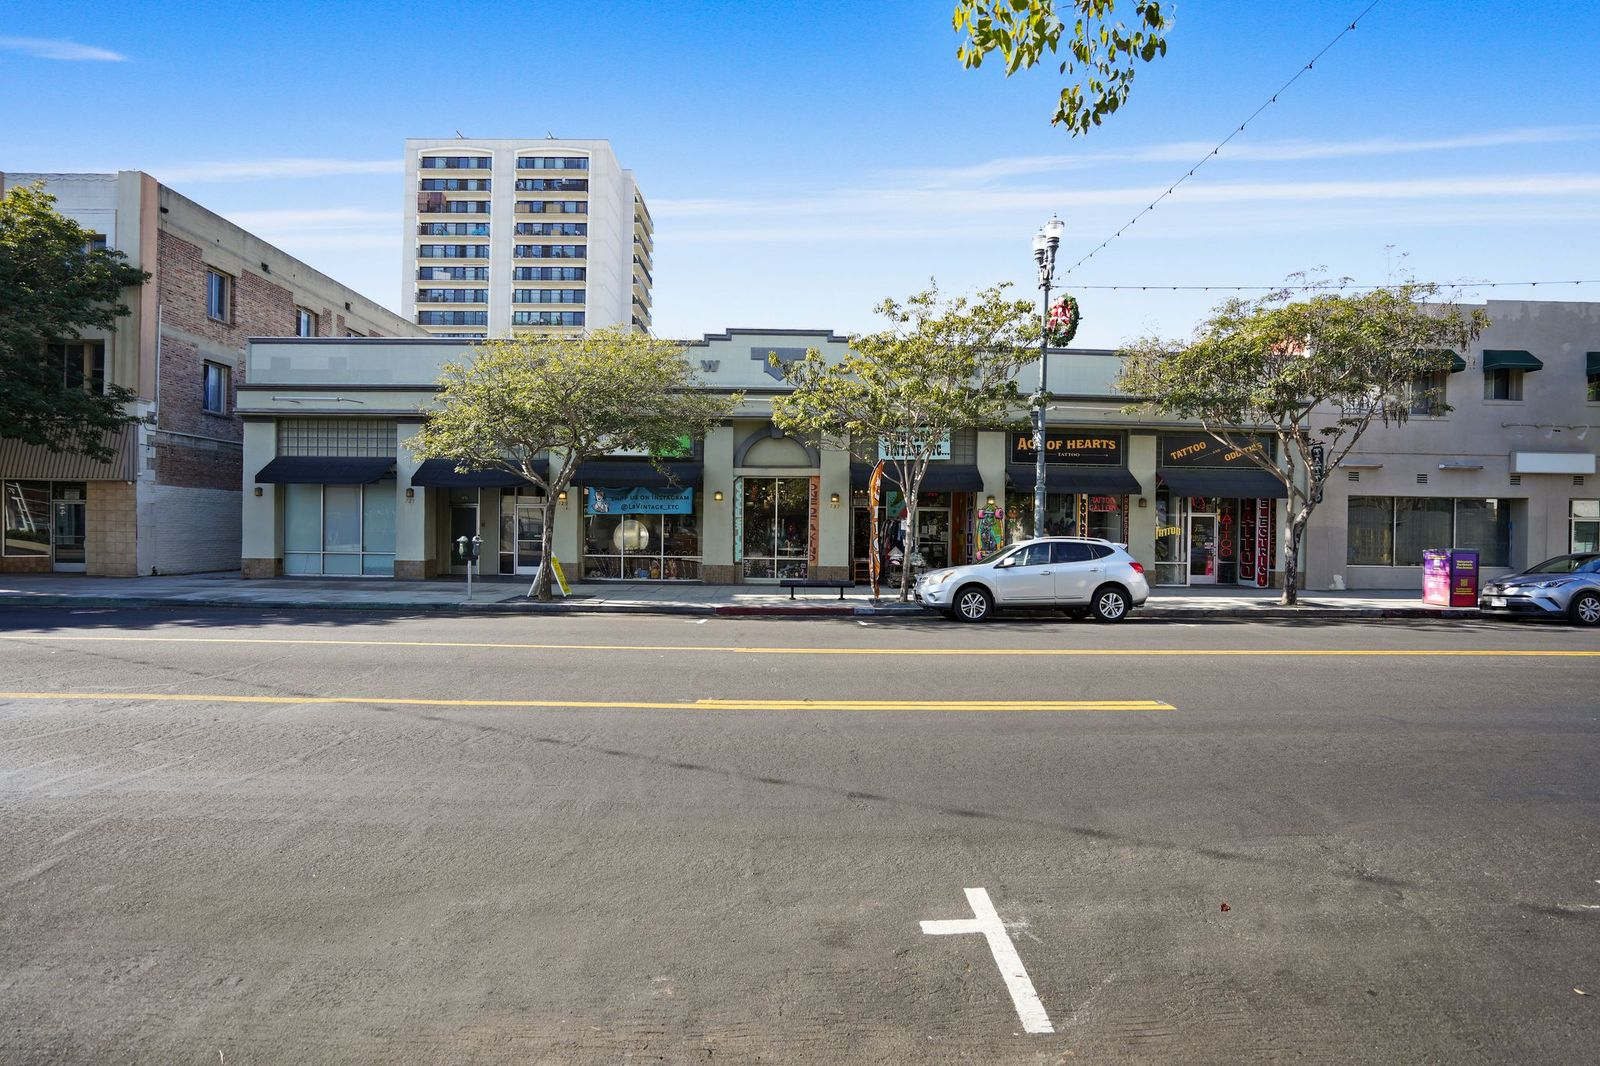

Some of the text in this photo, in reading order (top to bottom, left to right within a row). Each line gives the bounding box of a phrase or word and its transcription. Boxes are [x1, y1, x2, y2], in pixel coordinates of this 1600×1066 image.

[1017, 437, 1116, 450] AC OF HEARTS
[1170, 441, 1207, 460] TATTOO
